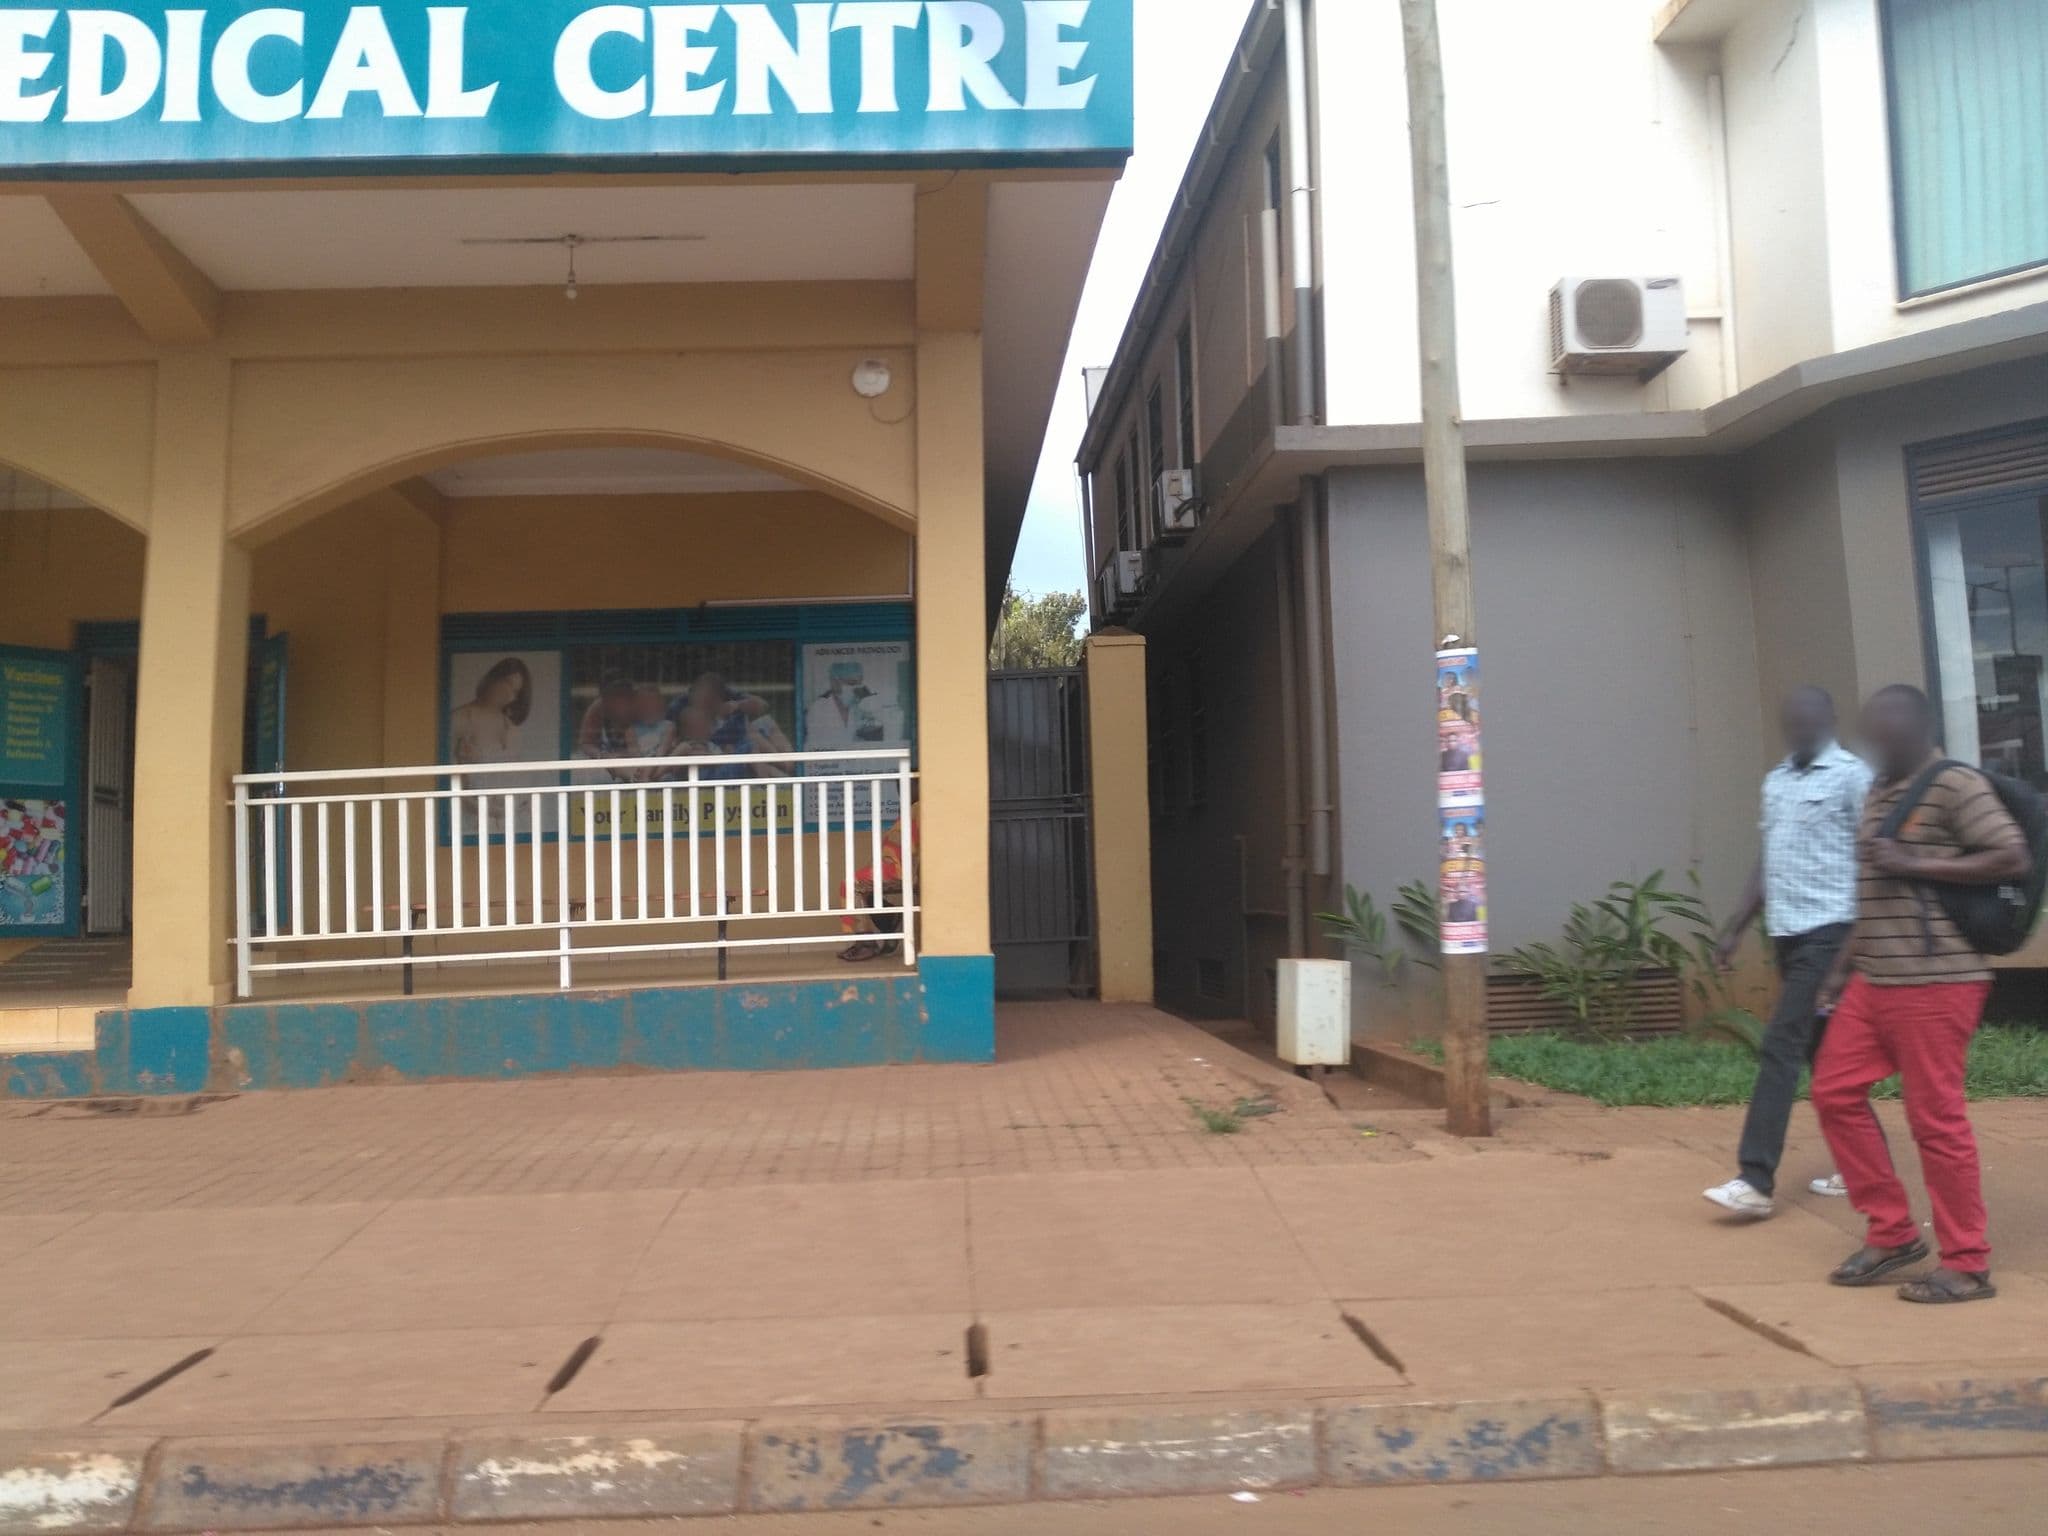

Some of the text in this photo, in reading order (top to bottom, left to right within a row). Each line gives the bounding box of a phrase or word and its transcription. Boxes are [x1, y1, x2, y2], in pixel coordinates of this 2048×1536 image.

[0, 0, 1098, 123] EDICAL CENTRE
[580, 806, 627, 824] or
[633, 803, 691, 825] amily
[703, 800, 788, 824] Pycin
